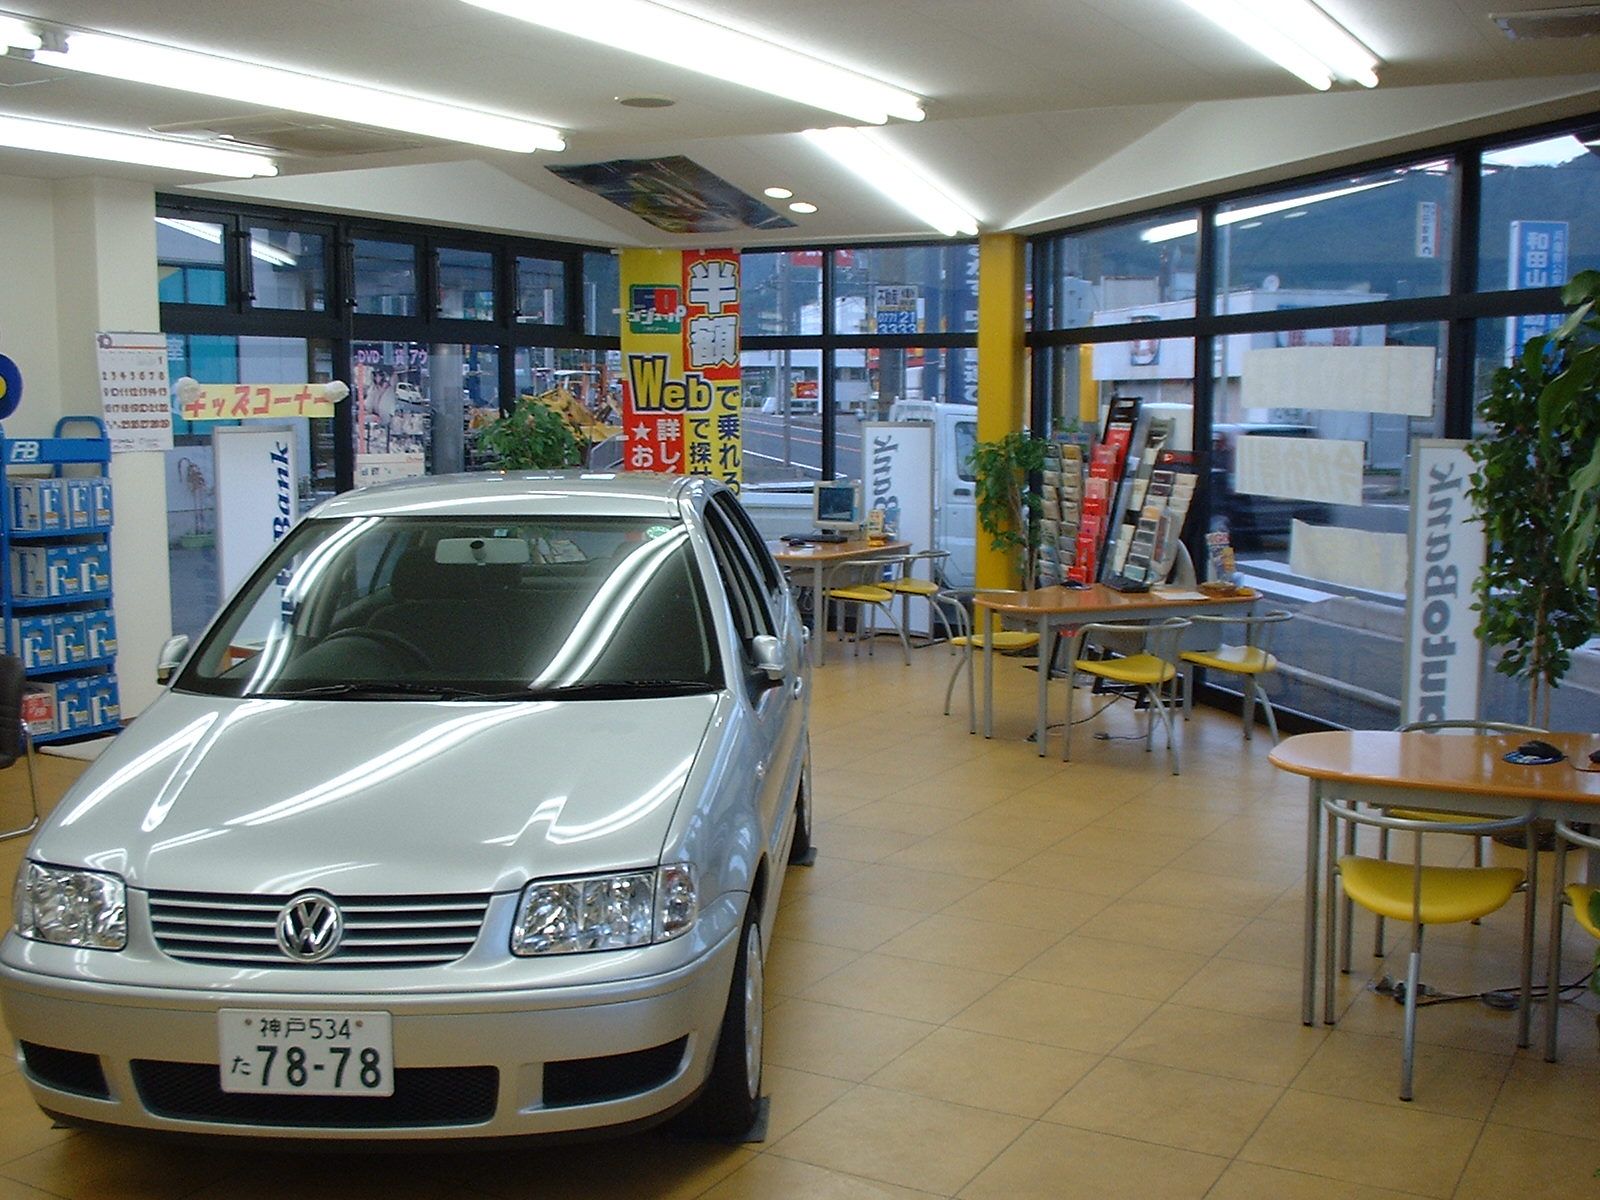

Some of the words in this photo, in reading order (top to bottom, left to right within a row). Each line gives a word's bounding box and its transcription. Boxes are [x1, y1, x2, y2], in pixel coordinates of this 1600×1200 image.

[689, 261, 738, 370] 半額
[184, 386, 333, 417] キッズコーナー
[629, 355, 714, 411] Web
[689, 418, 712, 476] で探
[716, 386, 740, 491] で乗れる
[231, 1055, 252, 1076] た
[256, 1045, 382, 1088] 78-78
